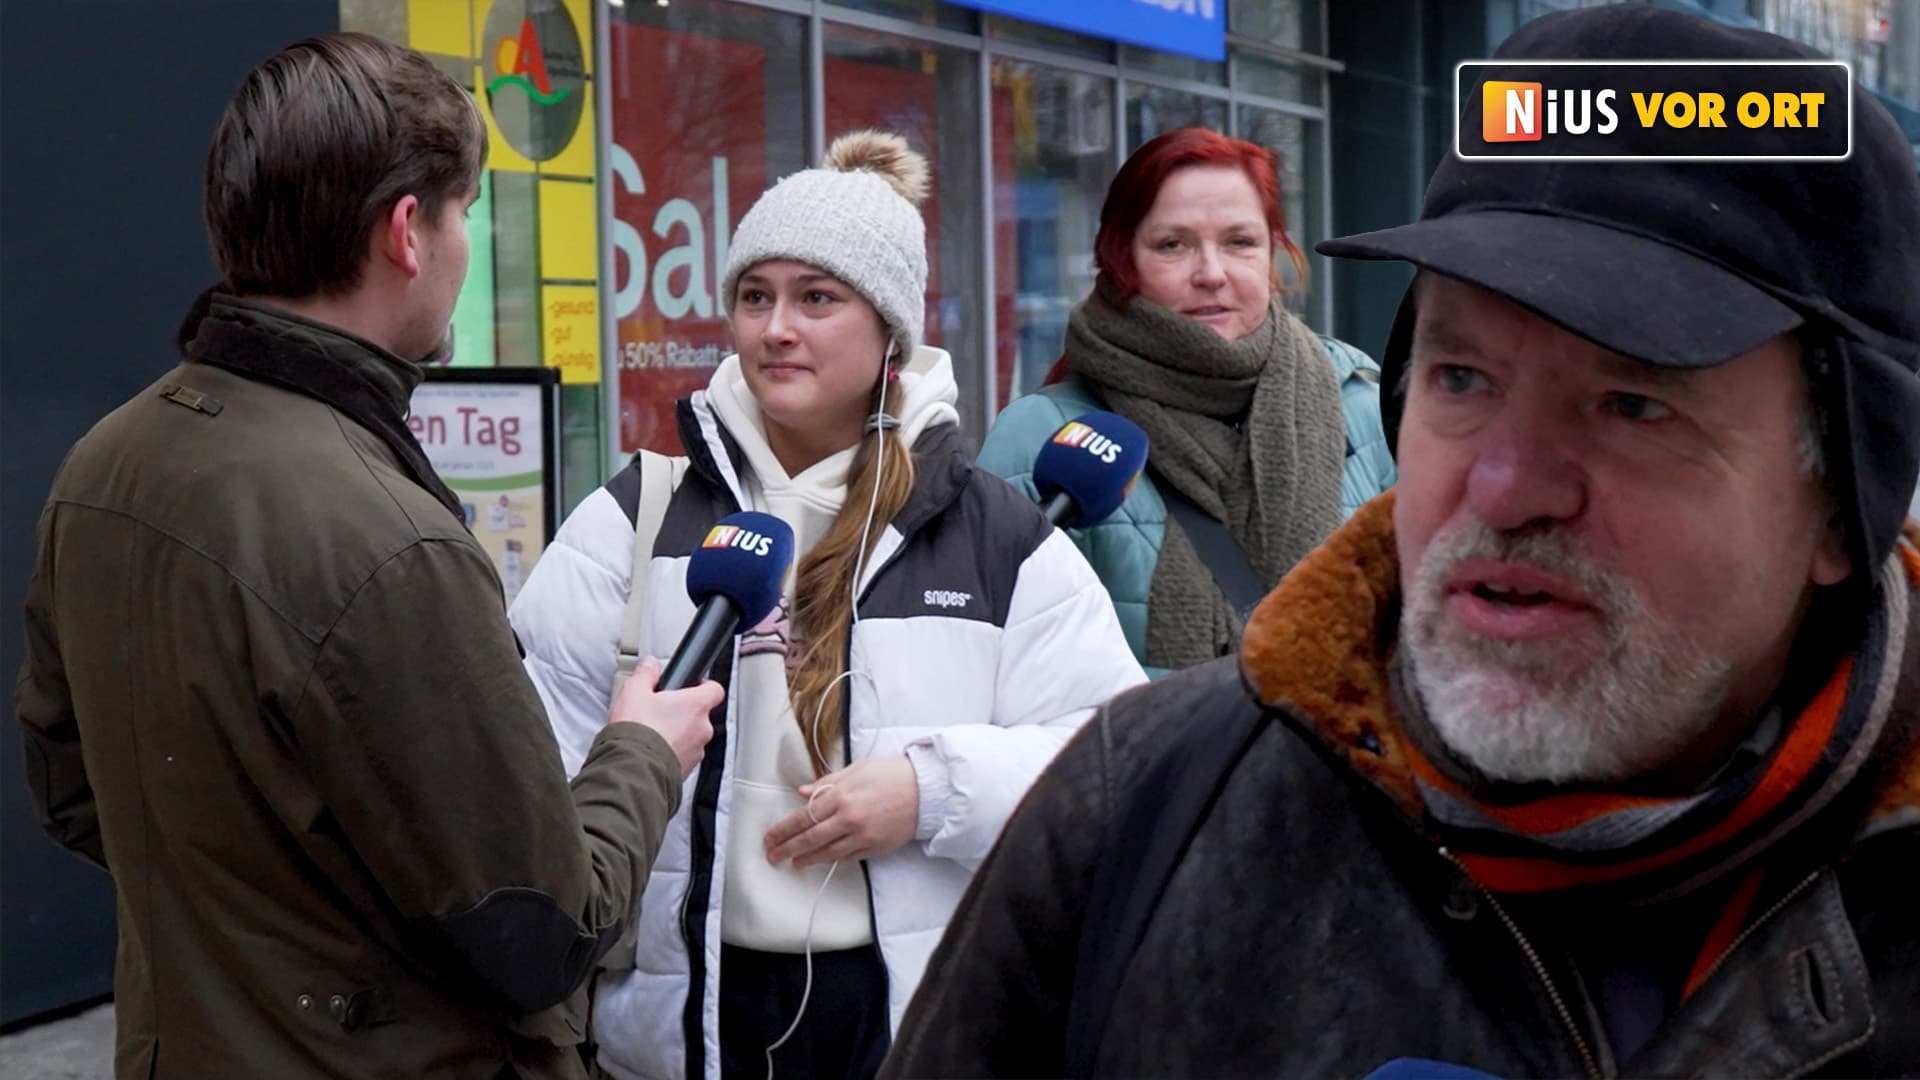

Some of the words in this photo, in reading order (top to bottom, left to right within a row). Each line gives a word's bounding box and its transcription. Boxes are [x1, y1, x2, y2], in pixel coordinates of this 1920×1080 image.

[625, 342, 664, 369] 50%
[666, 341, 718, 368] Rabatt
[457, 407, 523, 456] Tag
[924, 590, 967, 608] snipes
